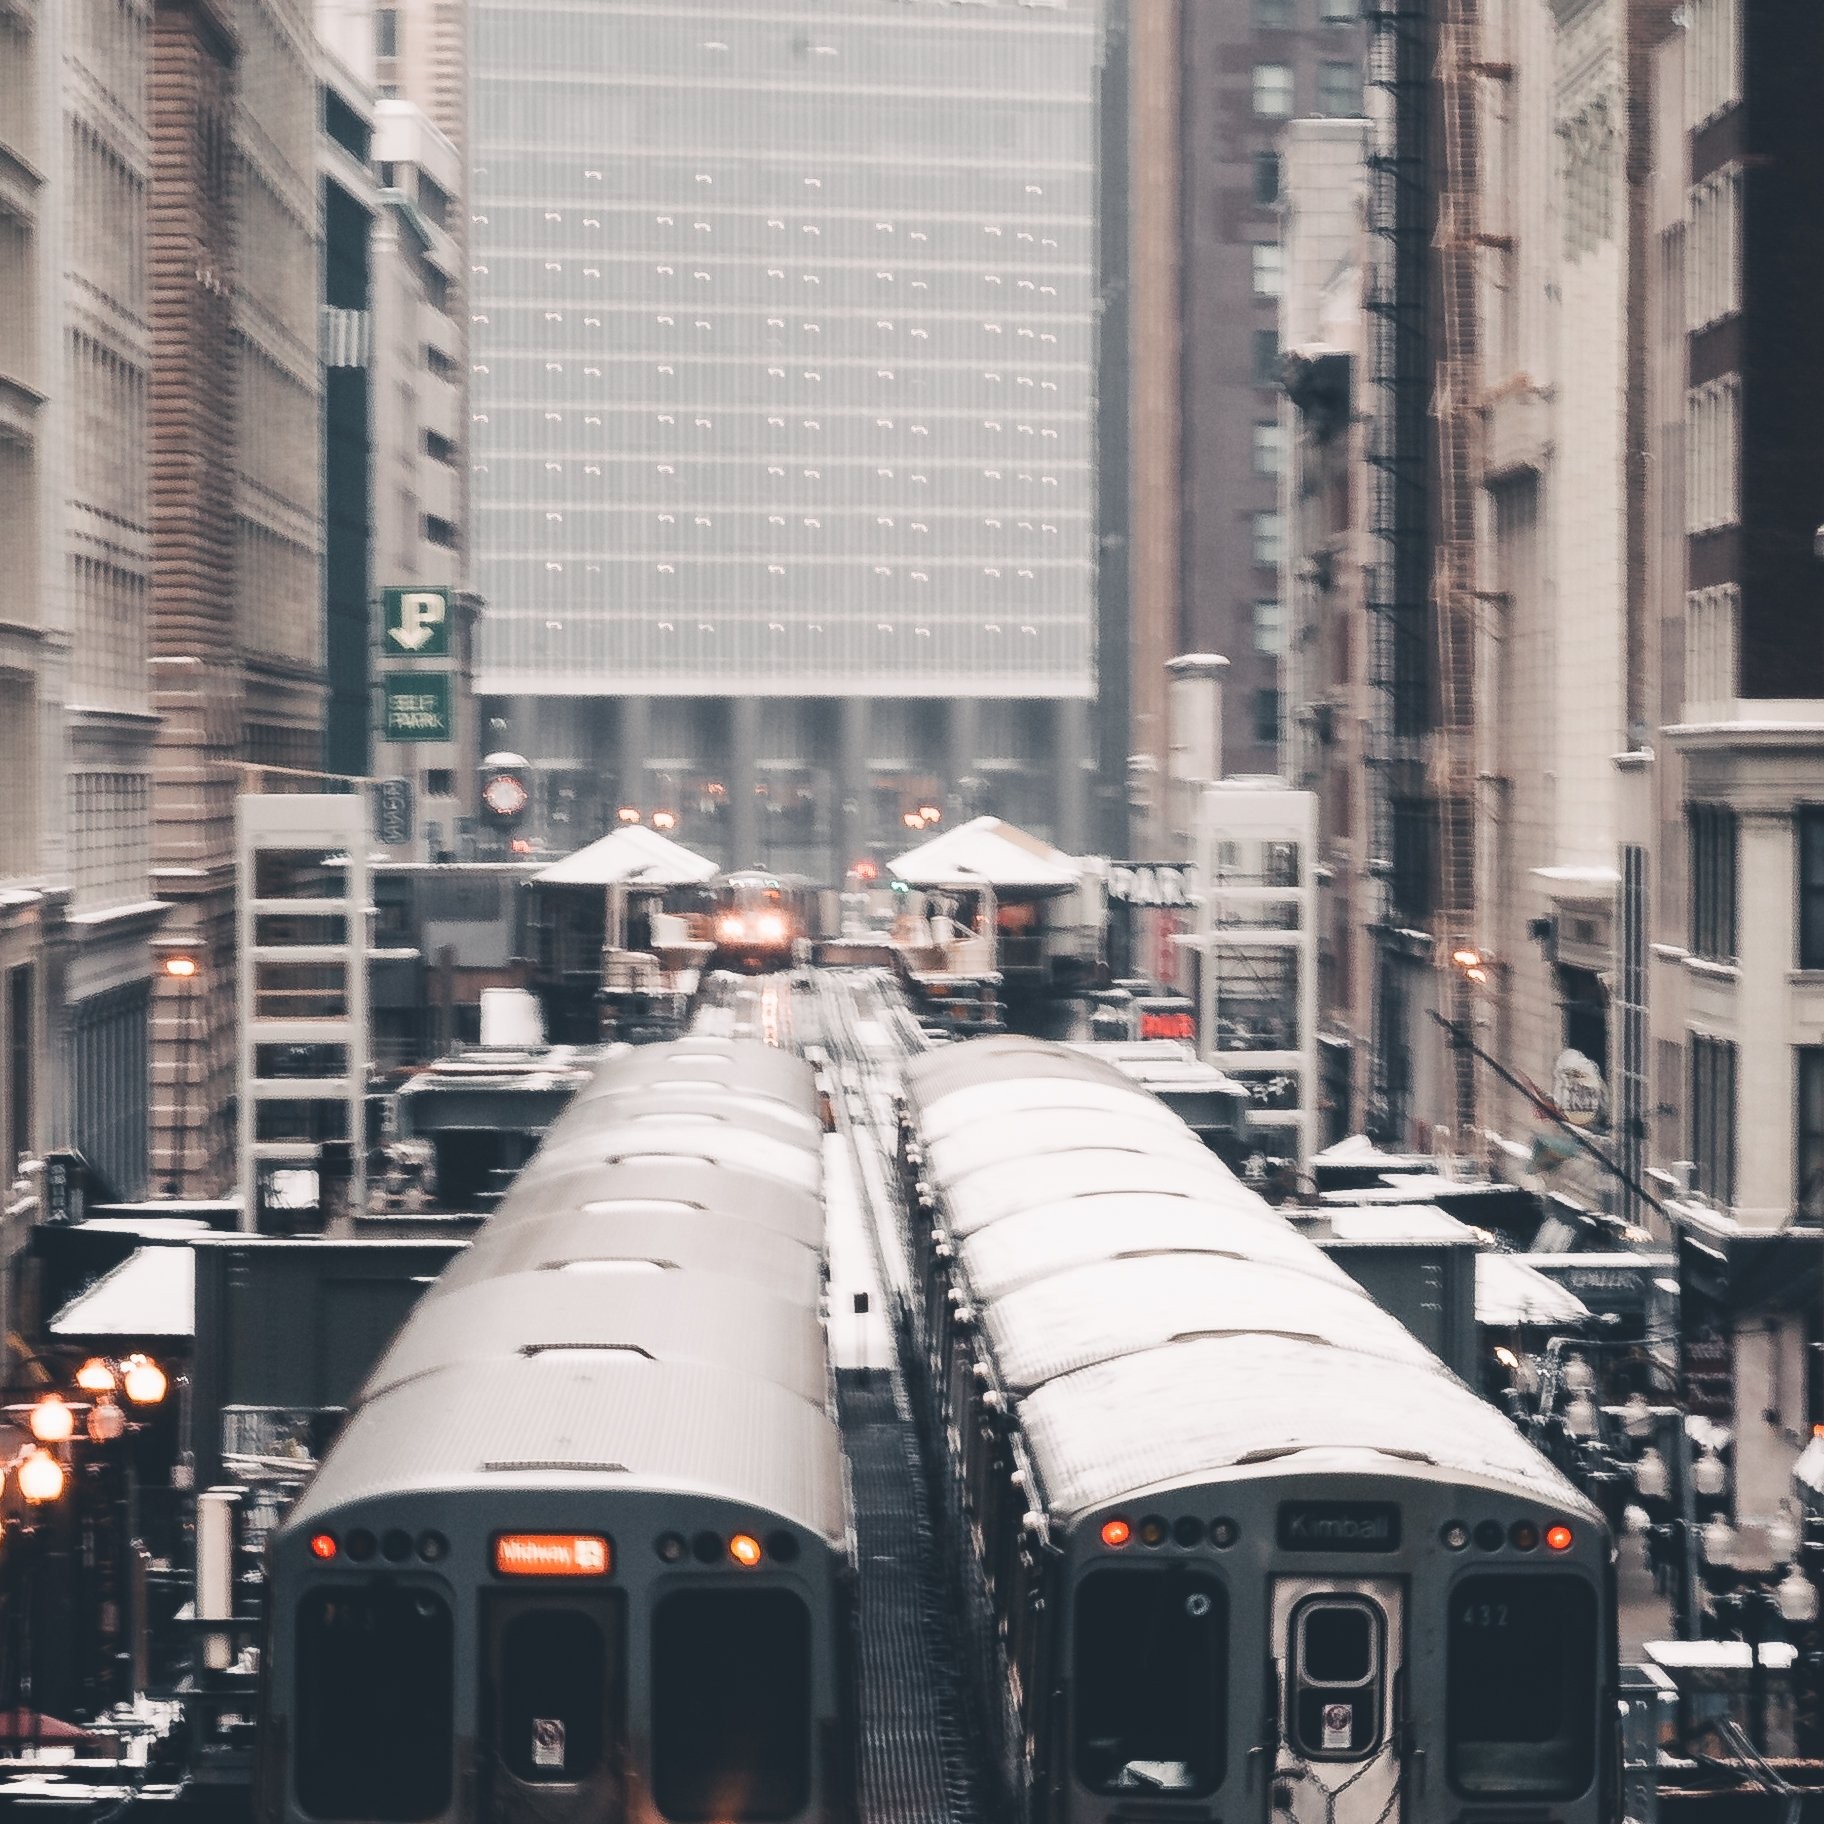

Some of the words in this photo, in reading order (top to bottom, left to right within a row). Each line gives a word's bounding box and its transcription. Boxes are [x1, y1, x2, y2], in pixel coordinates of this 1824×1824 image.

[392, 592, 446, 651] P
[1289, 1512, 1389, 1539] Kimball
[499, 1539, 571, 1567] Midway
